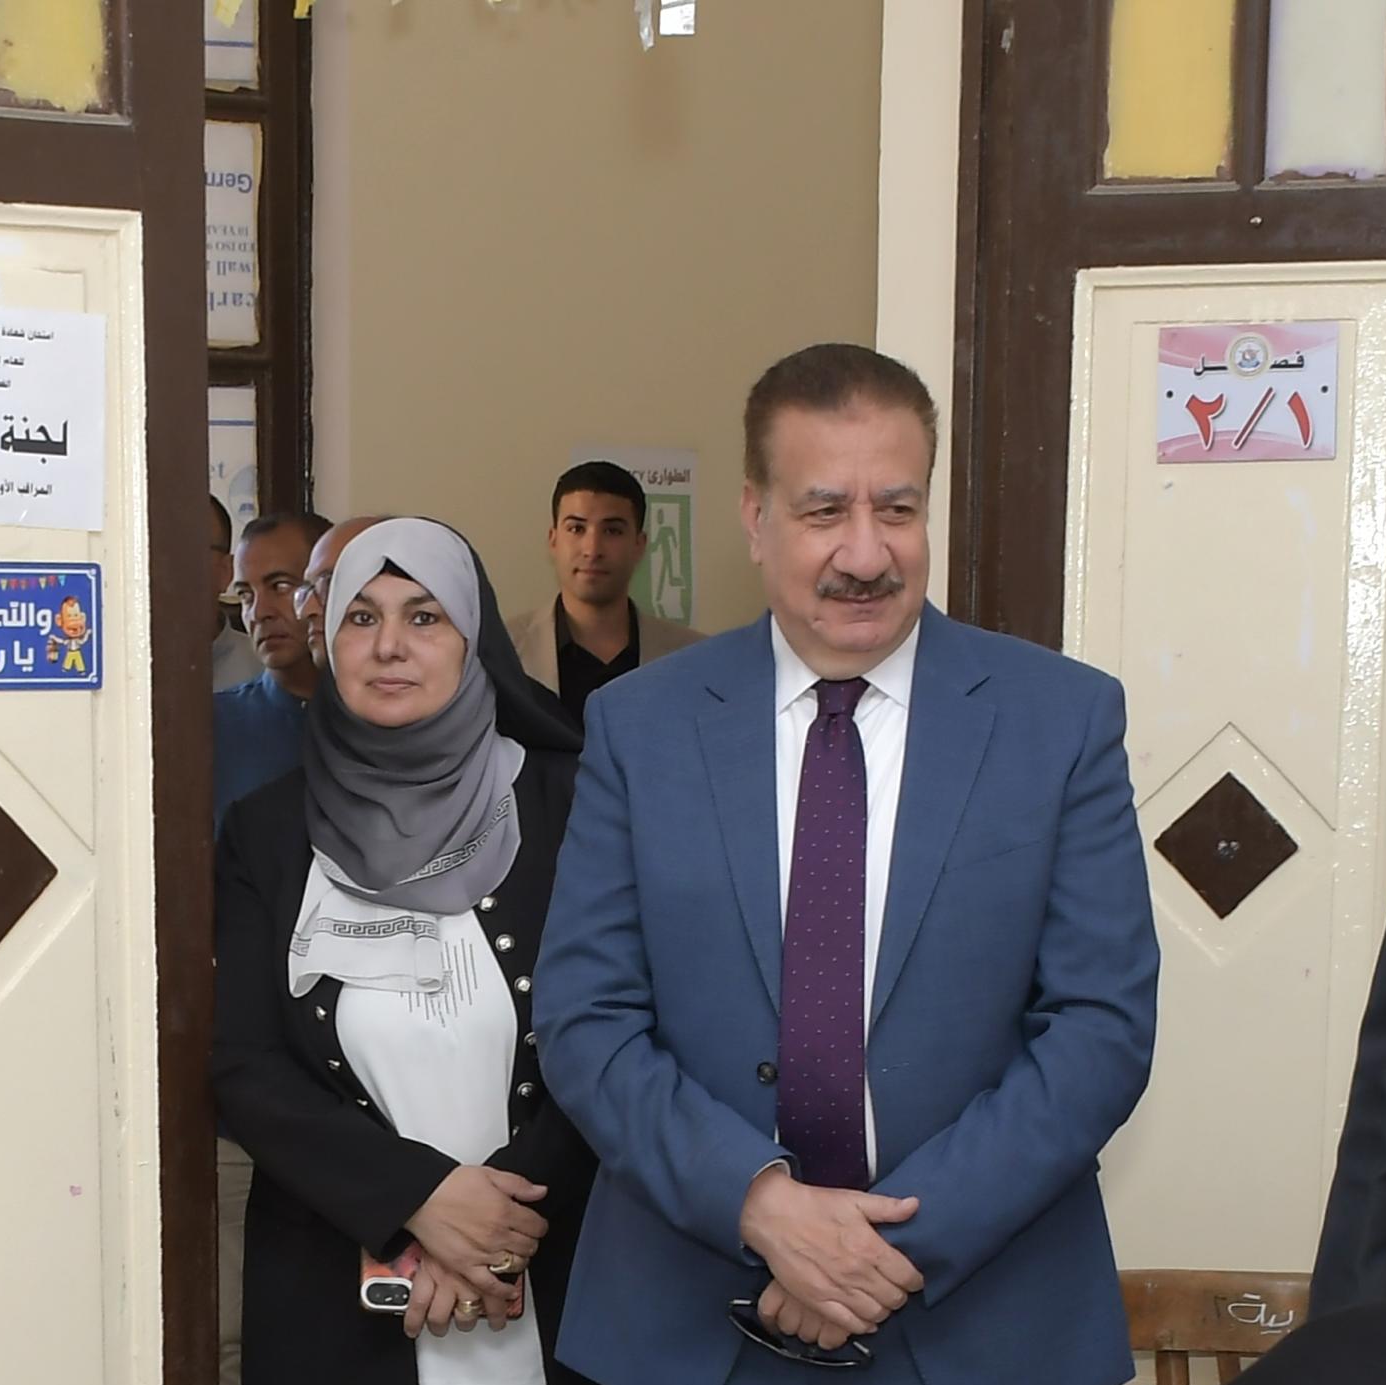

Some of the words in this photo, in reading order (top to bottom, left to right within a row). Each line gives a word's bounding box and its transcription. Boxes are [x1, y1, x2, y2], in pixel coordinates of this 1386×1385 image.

[1193, 350, 1305, 376] فصل
[0, 415, 68, 464] لجنة
[13, 640, 35, 672] يا
